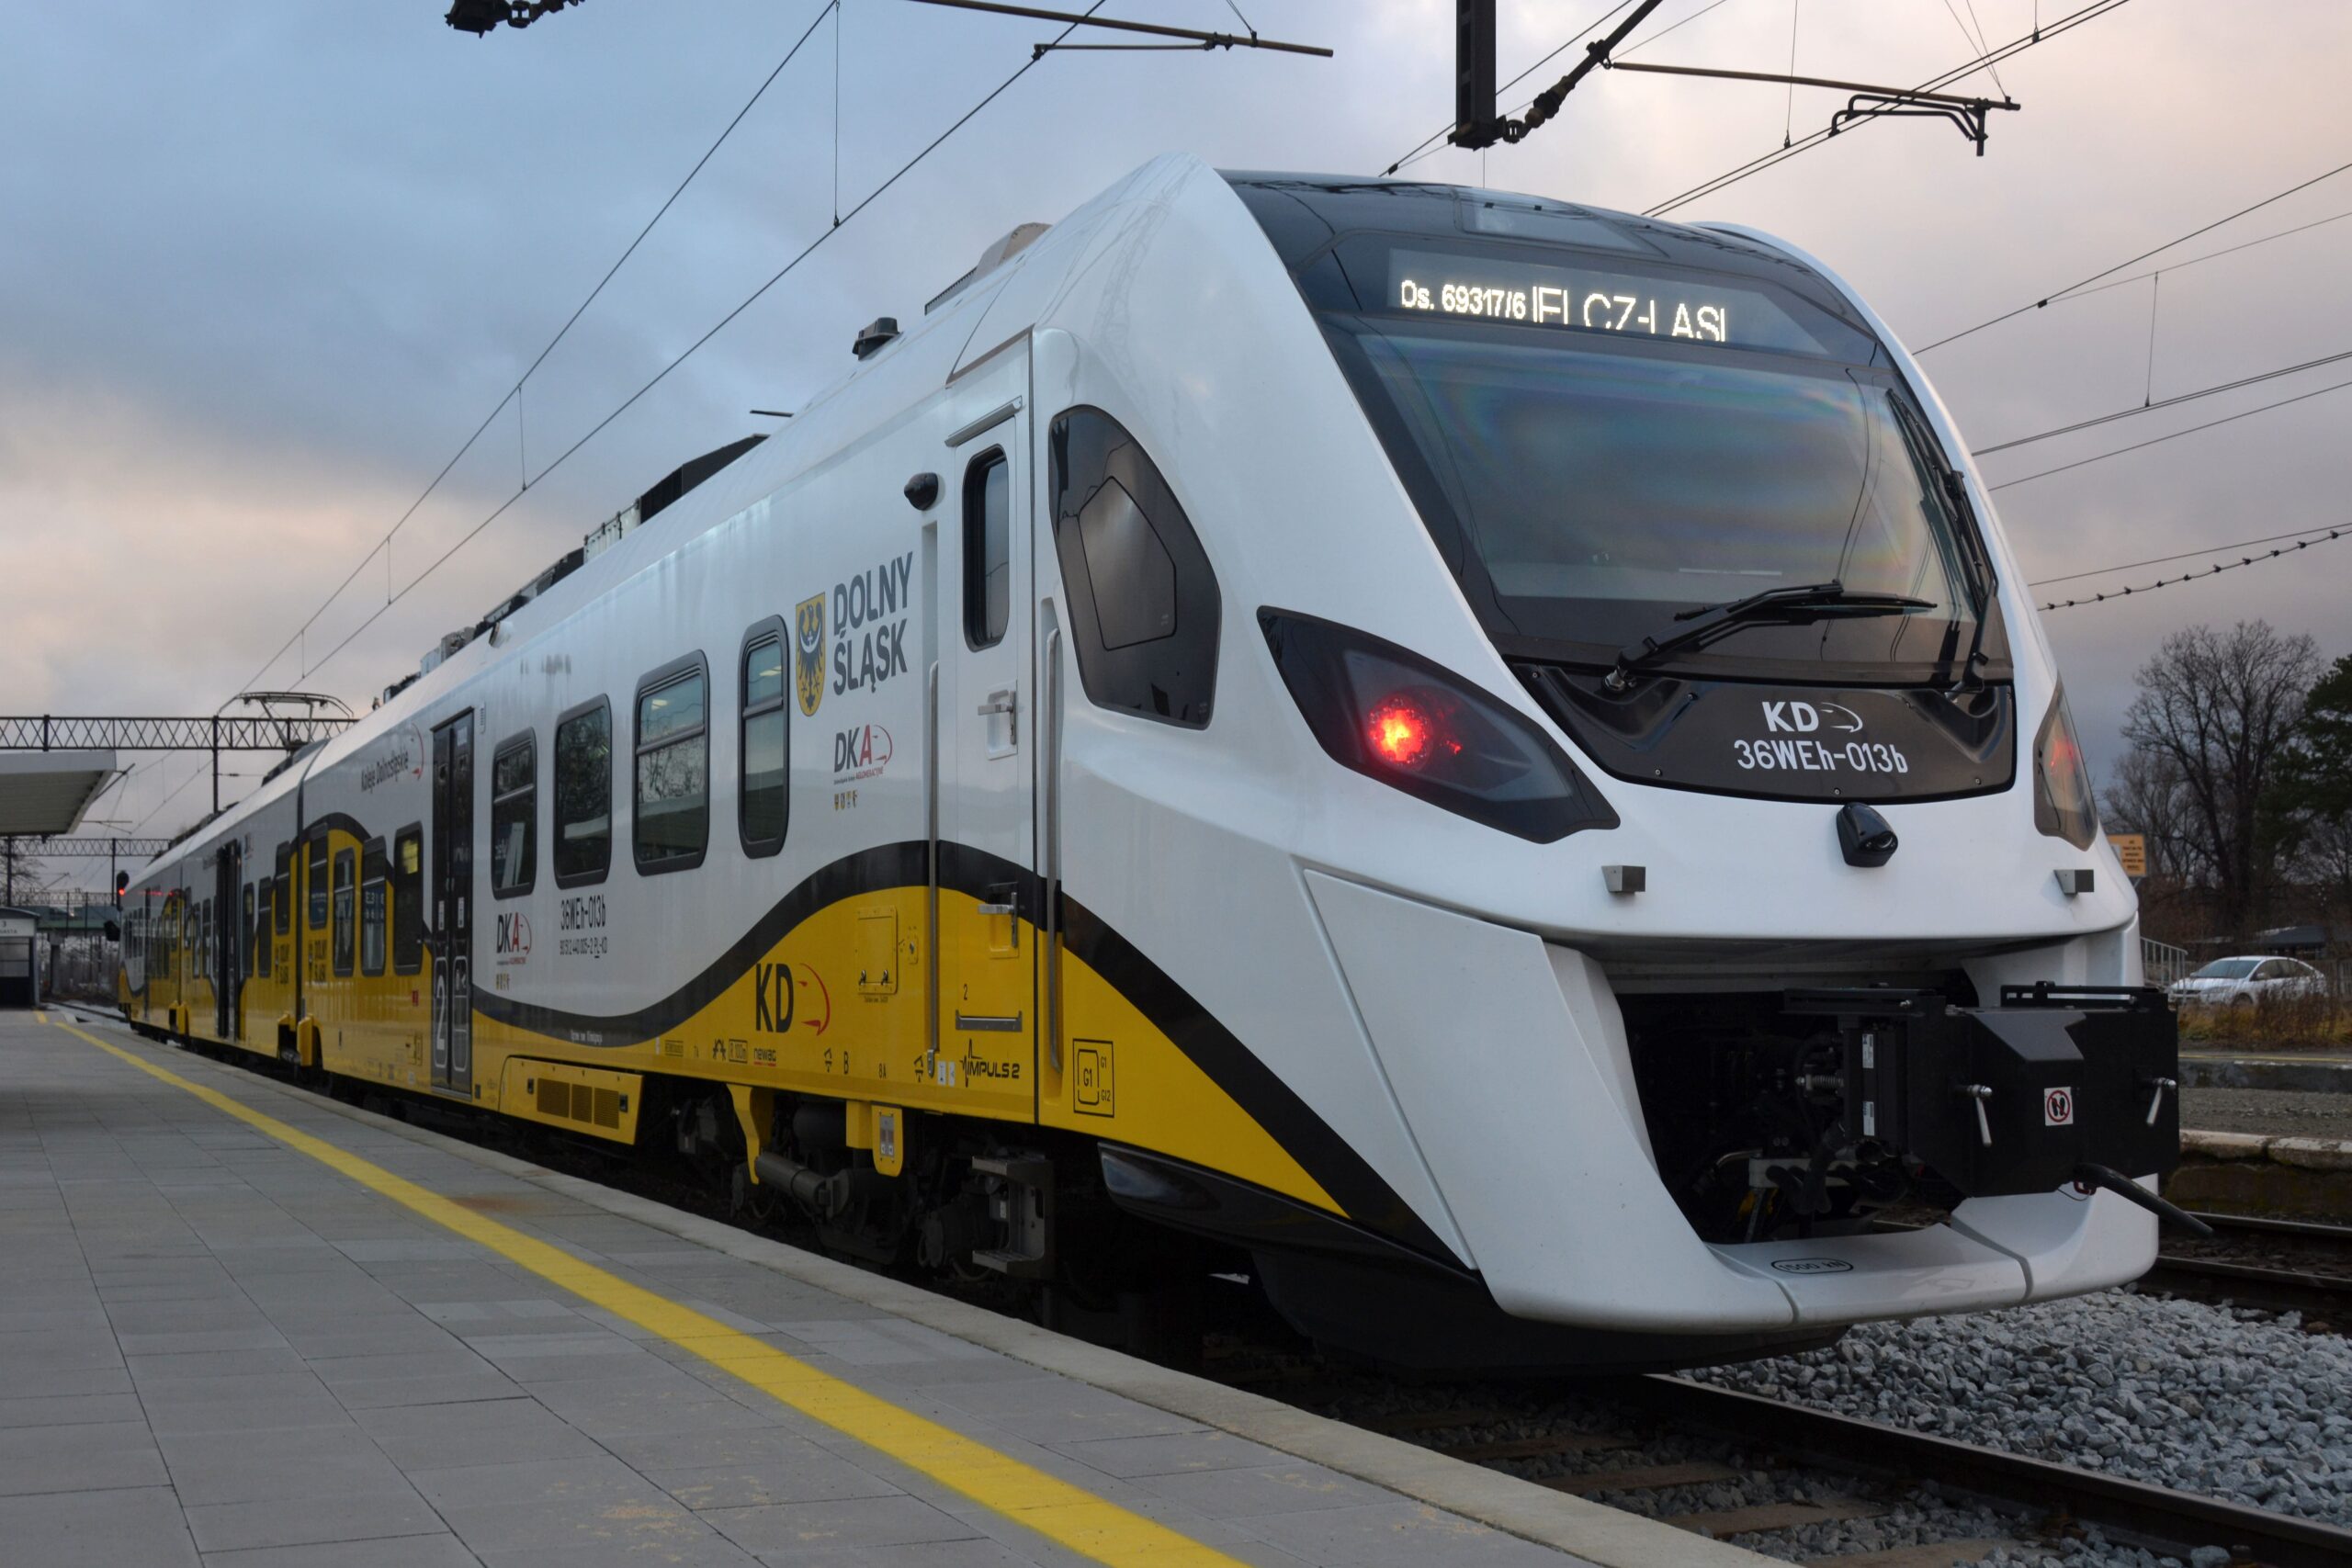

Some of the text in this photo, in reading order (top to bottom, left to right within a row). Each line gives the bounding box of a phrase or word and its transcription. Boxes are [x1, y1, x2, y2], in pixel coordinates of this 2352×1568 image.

[1401, 280, 1434, 310] Os.
[1442, 284, 1526, 321] 69317/6
[833, 551, 913, 636] DOLNY
[833, 618, 908, 696] ŚLĄSK
[1762, 701, 1819, 732] KD
[834, 724, 873, 773] DKA
[1734, 739, 1908, 773] 36WEh-013b
[497, 912, 519, 953] DKA
[560, 894, 606, 931] 36WEh-013b
[436, 975, 445, 1051] 2
[755, 963, 794, 1033] KD
[963, 984, 968, 1001] 2
[967, 1062, 1020, 1079] IMPULS 2
[1083, 1067, 1093, 1088] G1
